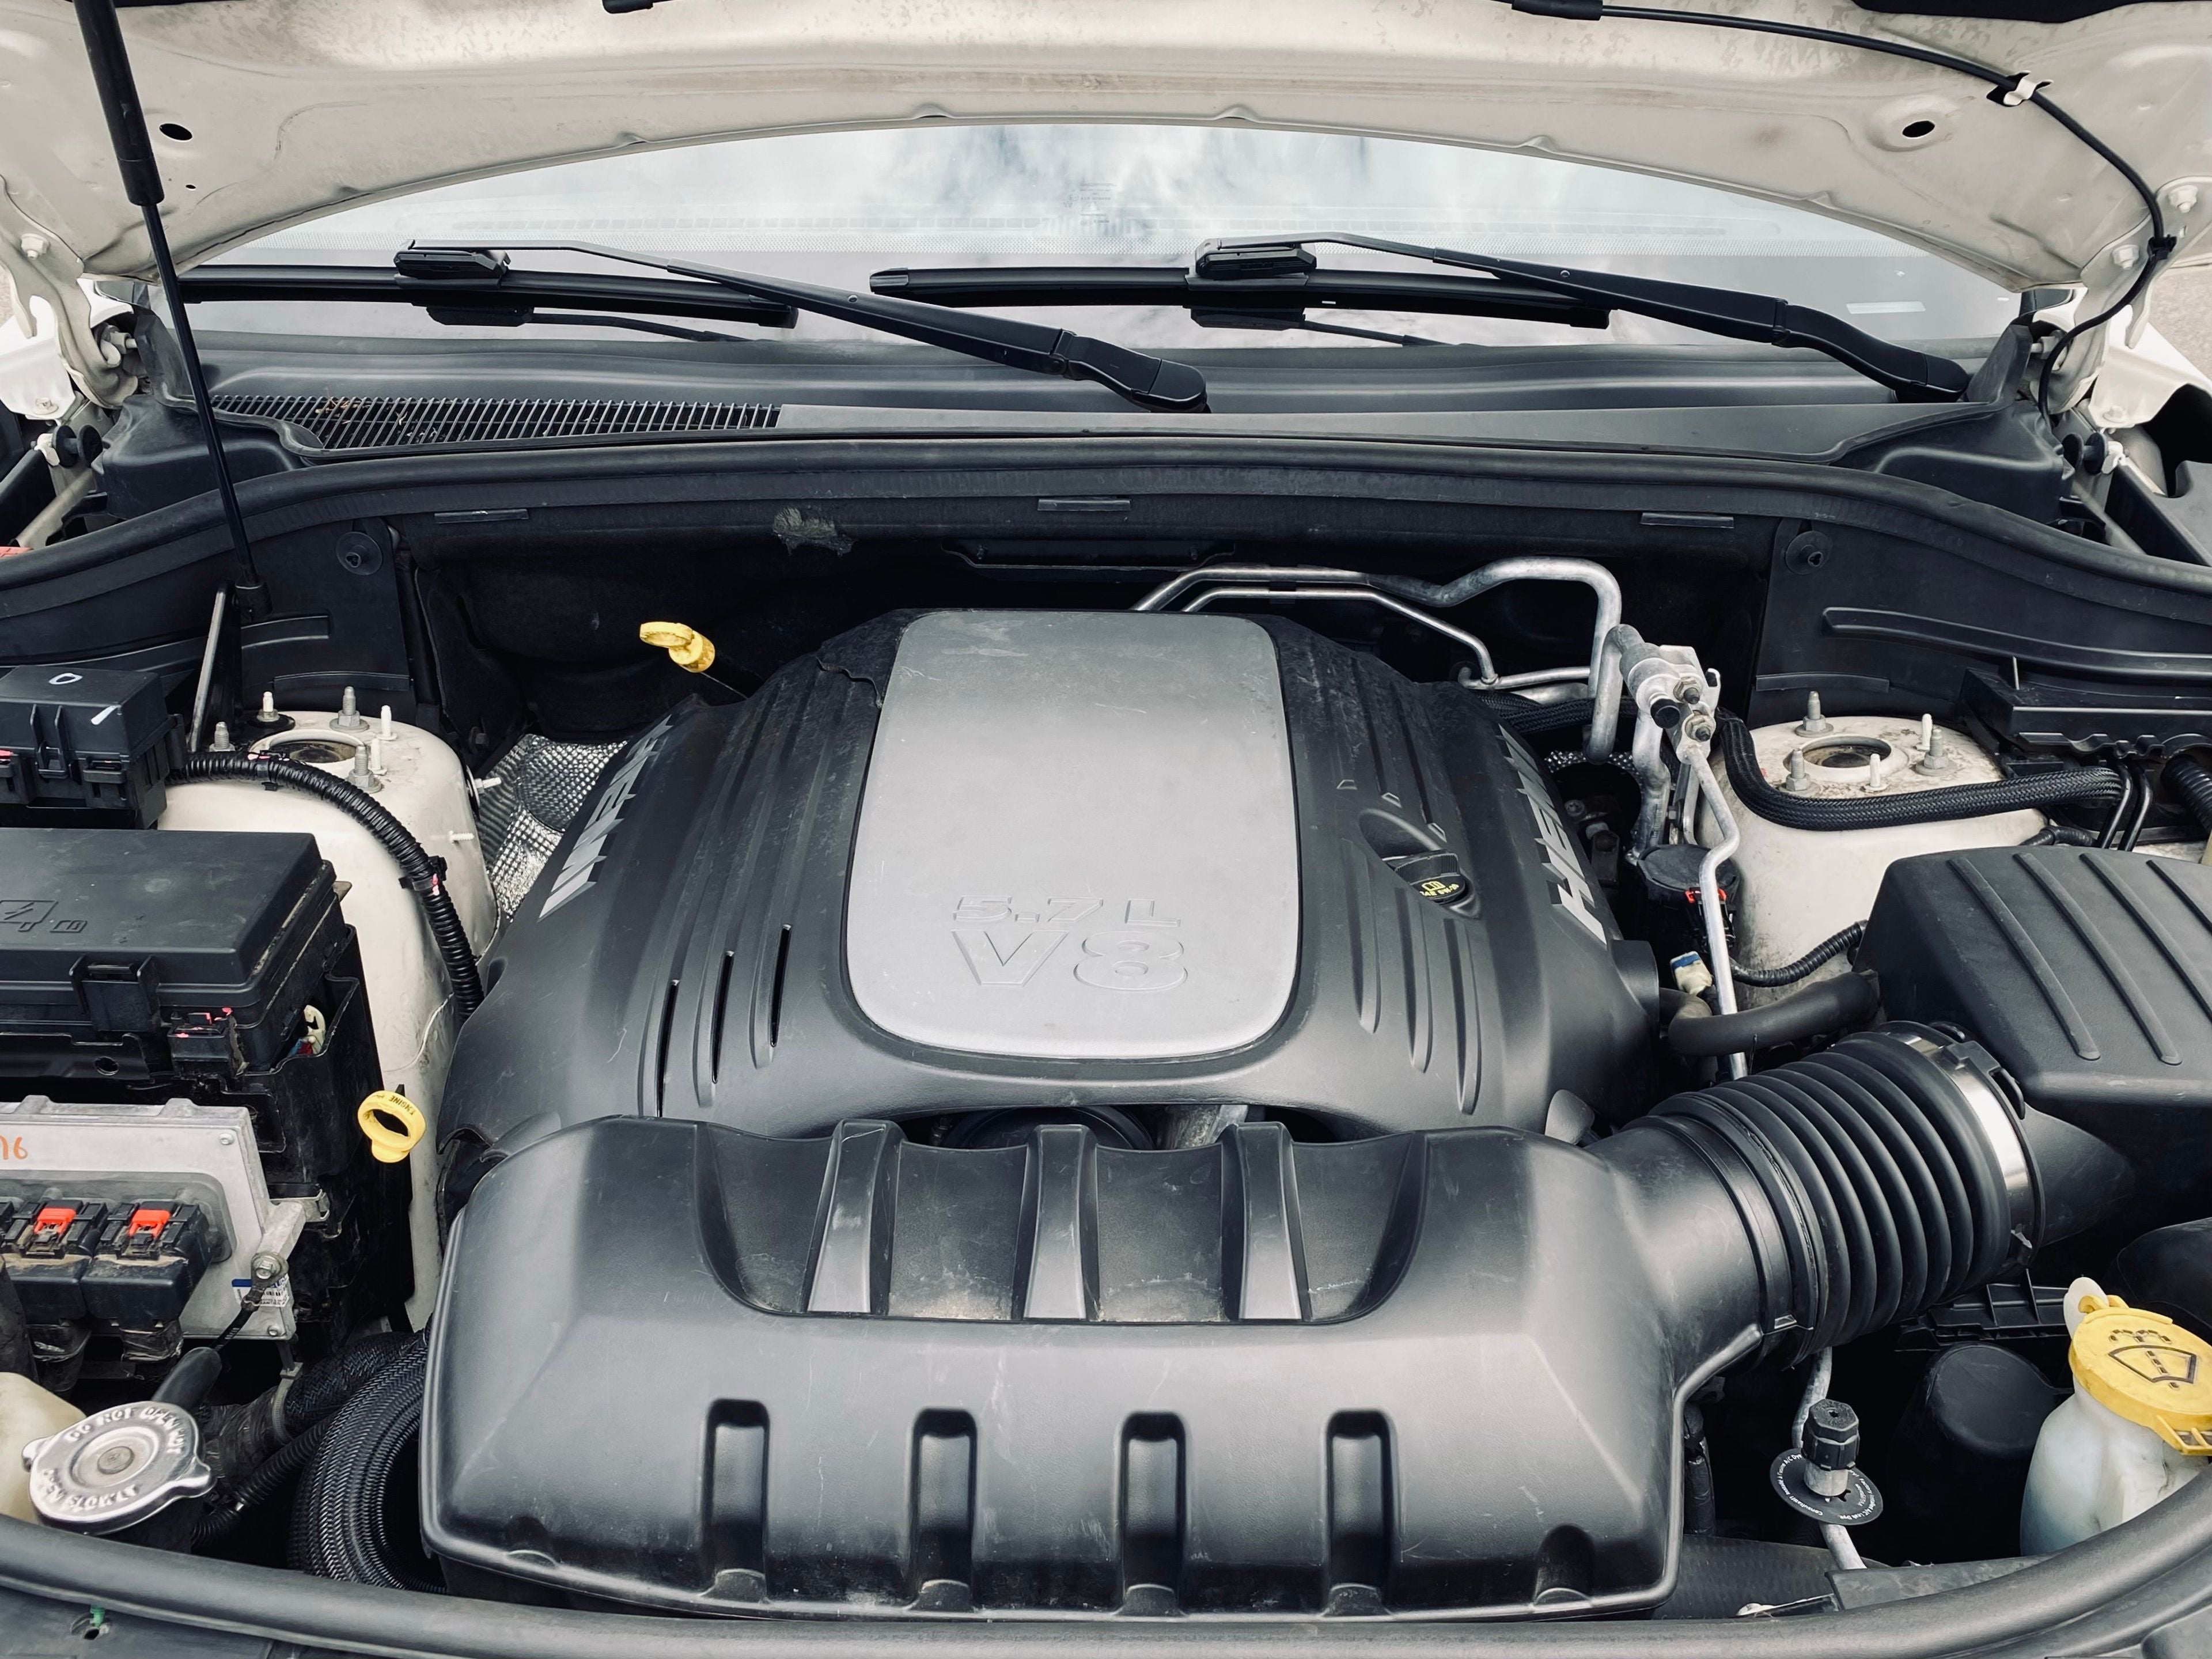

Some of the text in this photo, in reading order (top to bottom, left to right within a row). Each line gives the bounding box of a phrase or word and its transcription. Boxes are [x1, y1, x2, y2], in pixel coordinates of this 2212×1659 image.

[1496, 724, 1607, 949] HEMI
[951, 929, 1189, 991] V8
[389, 1095, 415, 1115] ENGINE
[63, 1423, 91, 1442] DO
[96, 1407, 139, 1425] NOT
